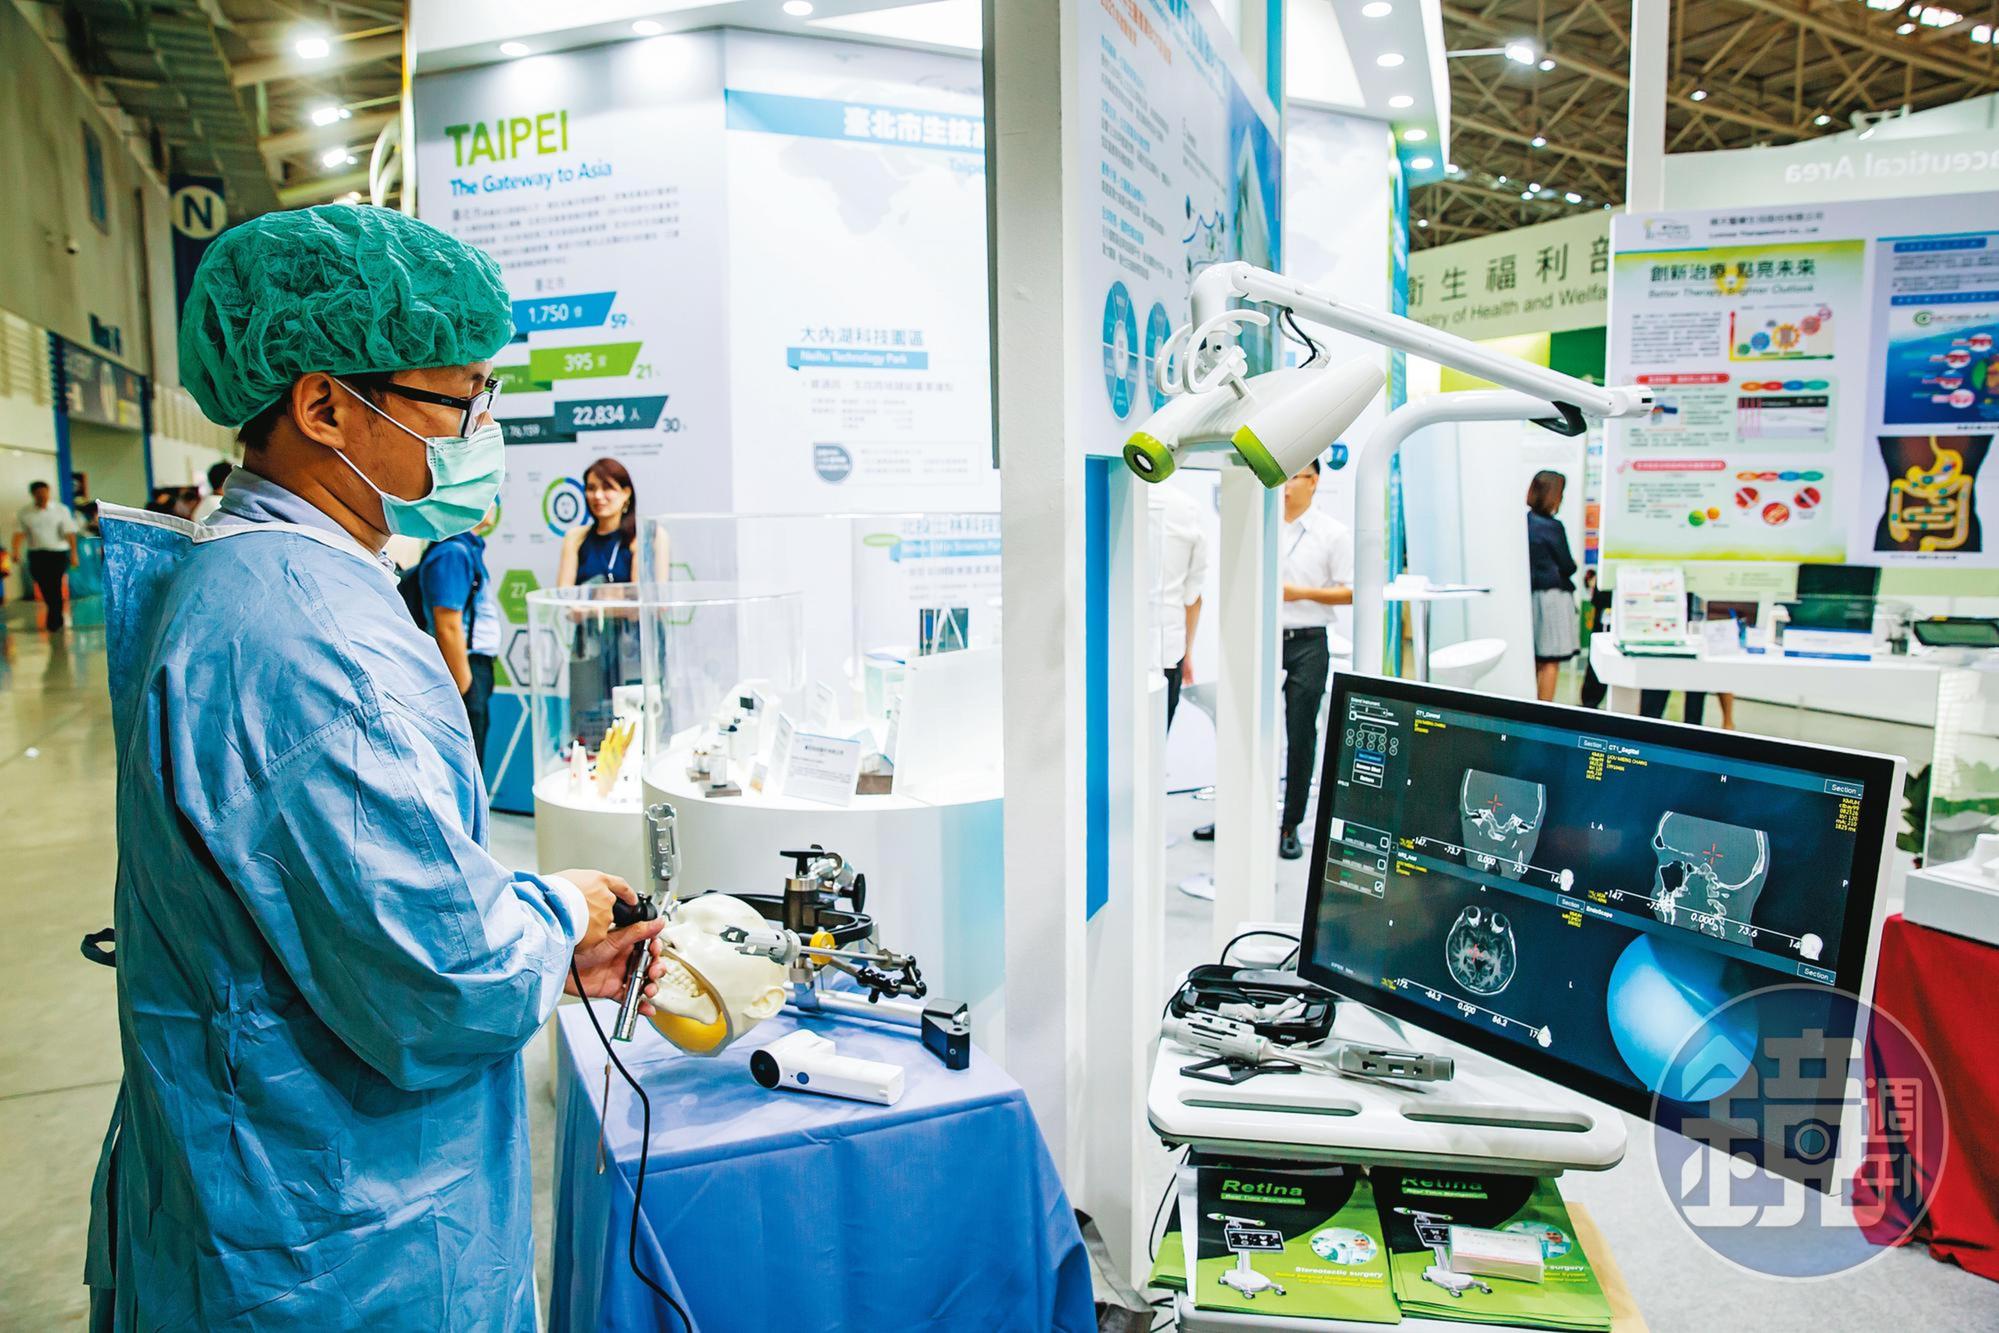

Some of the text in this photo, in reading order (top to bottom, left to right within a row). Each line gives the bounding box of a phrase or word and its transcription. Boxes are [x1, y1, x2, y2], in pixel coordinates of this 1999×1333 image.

[445, 110, 568, 167] TAIPEI
[450, 159, 612, 197] The Gateway to Asia
[183, 194, 212, 230] N
[1471, 297, 1519, 321] Health
[1523, 292, 1553, 312] and
[564, 353, 594, 372] 395
[573, 405, 625, 426] 22,834
[1720, 774, 1727, 783] H
[1831, 783, 1857, 795] Section
[1477, 854, 1496, 866] 0.000
[1512, 864, 1528, 875] 73.7
[1842, 879, 1849, 888] P
[1690, 912, 1715, 926] 0.000
[1737, 925, 1758, 938] 73.6
[1804, 967, 1830, 981] Section
[1457, 1002, 1476, 1015] 0.000
[1222, 1179, 1303, 1197] Retina
[1295, 1266, 1383, 1279] Stereotactic surgery
